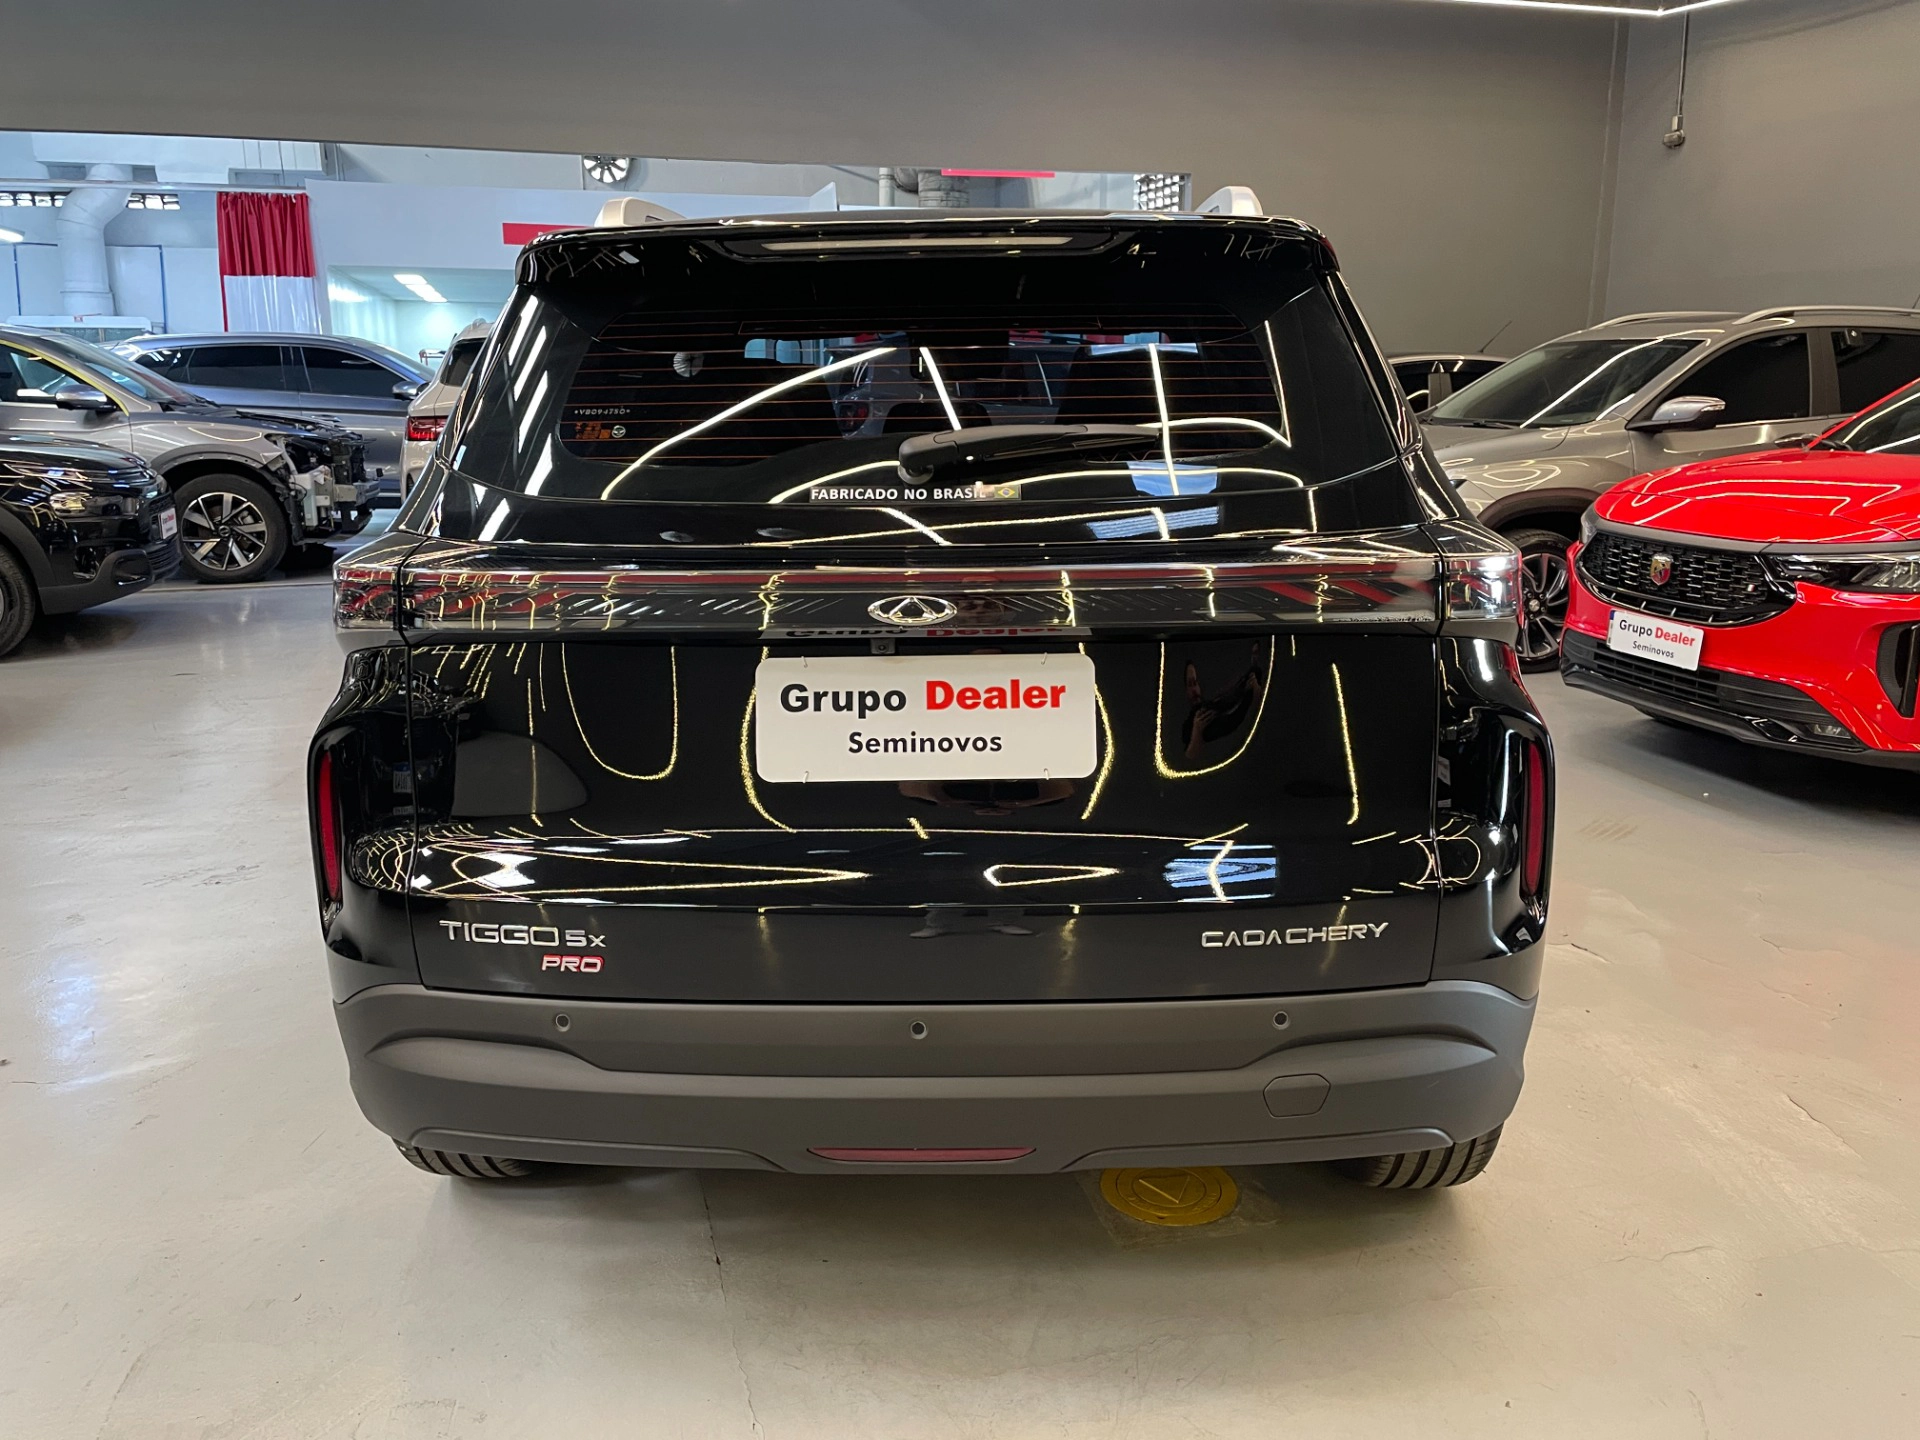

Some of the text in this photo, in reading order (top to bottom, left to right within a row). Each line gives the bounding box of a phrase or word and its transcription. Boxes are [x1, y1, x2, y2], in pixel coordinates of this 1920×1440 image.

[811, 486, 986, 500] FABRICADO NO BRASIL
[1619, 620, 1695, 646] Grupo Dealer
[1633, 641, 1674, 658] Seminovos
[780, 679, 1066, 719] Grupo Dealer
[848, 731, 1003, 754] Seminovos
[439, 920, 560, 947] TIGGO
[541, 954, 604, 973] PRO
